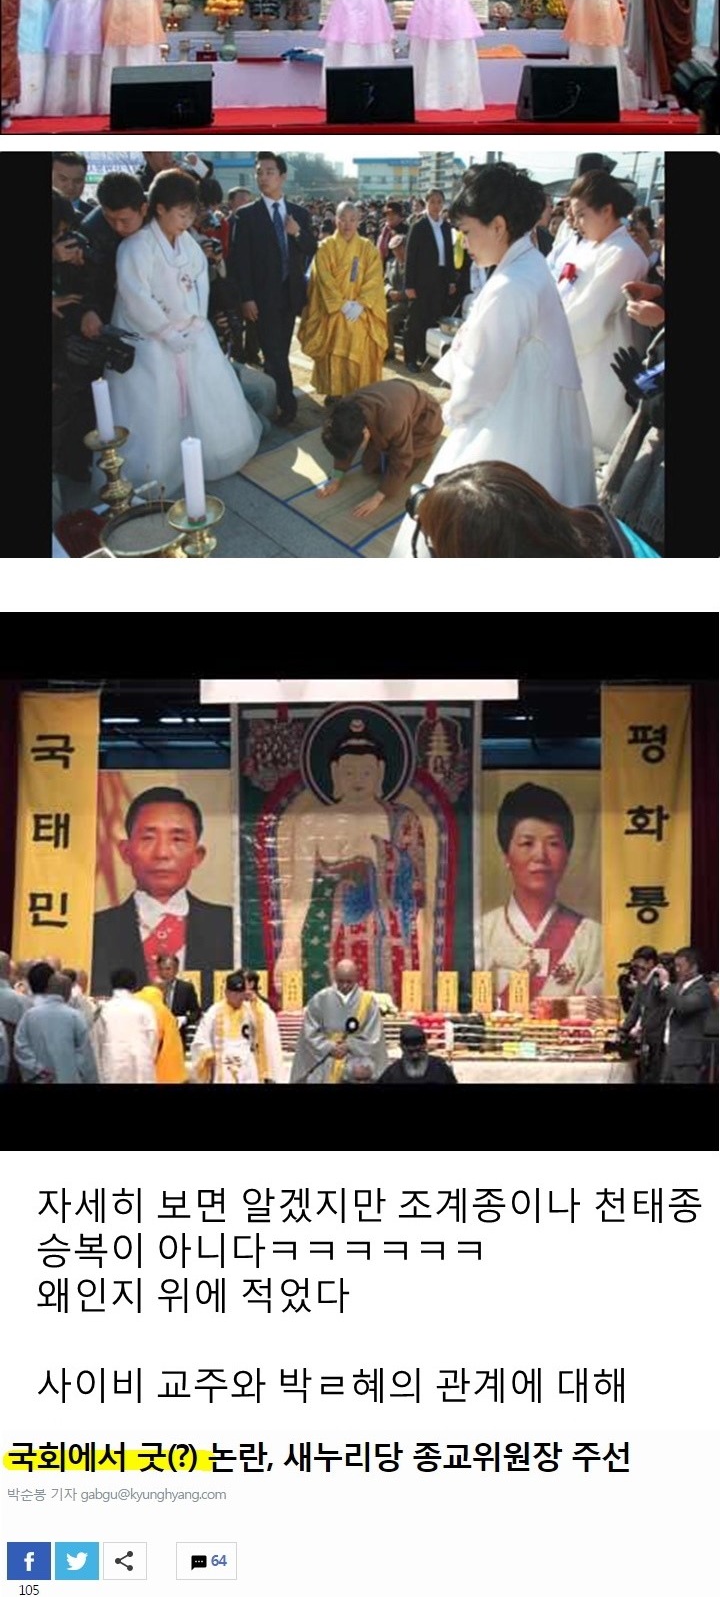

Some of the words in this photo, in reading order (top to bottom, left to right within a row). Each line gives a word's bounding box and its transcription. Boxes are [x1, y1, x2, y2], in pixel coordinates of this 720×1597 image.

[8, 1441, 125, 1473] 국회에서
[137, 1442, 198, 1473] 굿(?)
[208, 1441, 274, 1473] 논란,
[283, 1441, 404, 1473] 새누리당
[413, 1441, 563, 1473] 종교위원장
[572, 1441, 630, 1473] 주선
[7, 1487, 47, 1502] 박순봉
[50, 1487, 78, 1502] 기자
[80, 1487, 227, 1503] gabgu@kyunghyang.com
[210, 1554, 228, 1567] 64
[18, 1584, 40, 1595] 105
